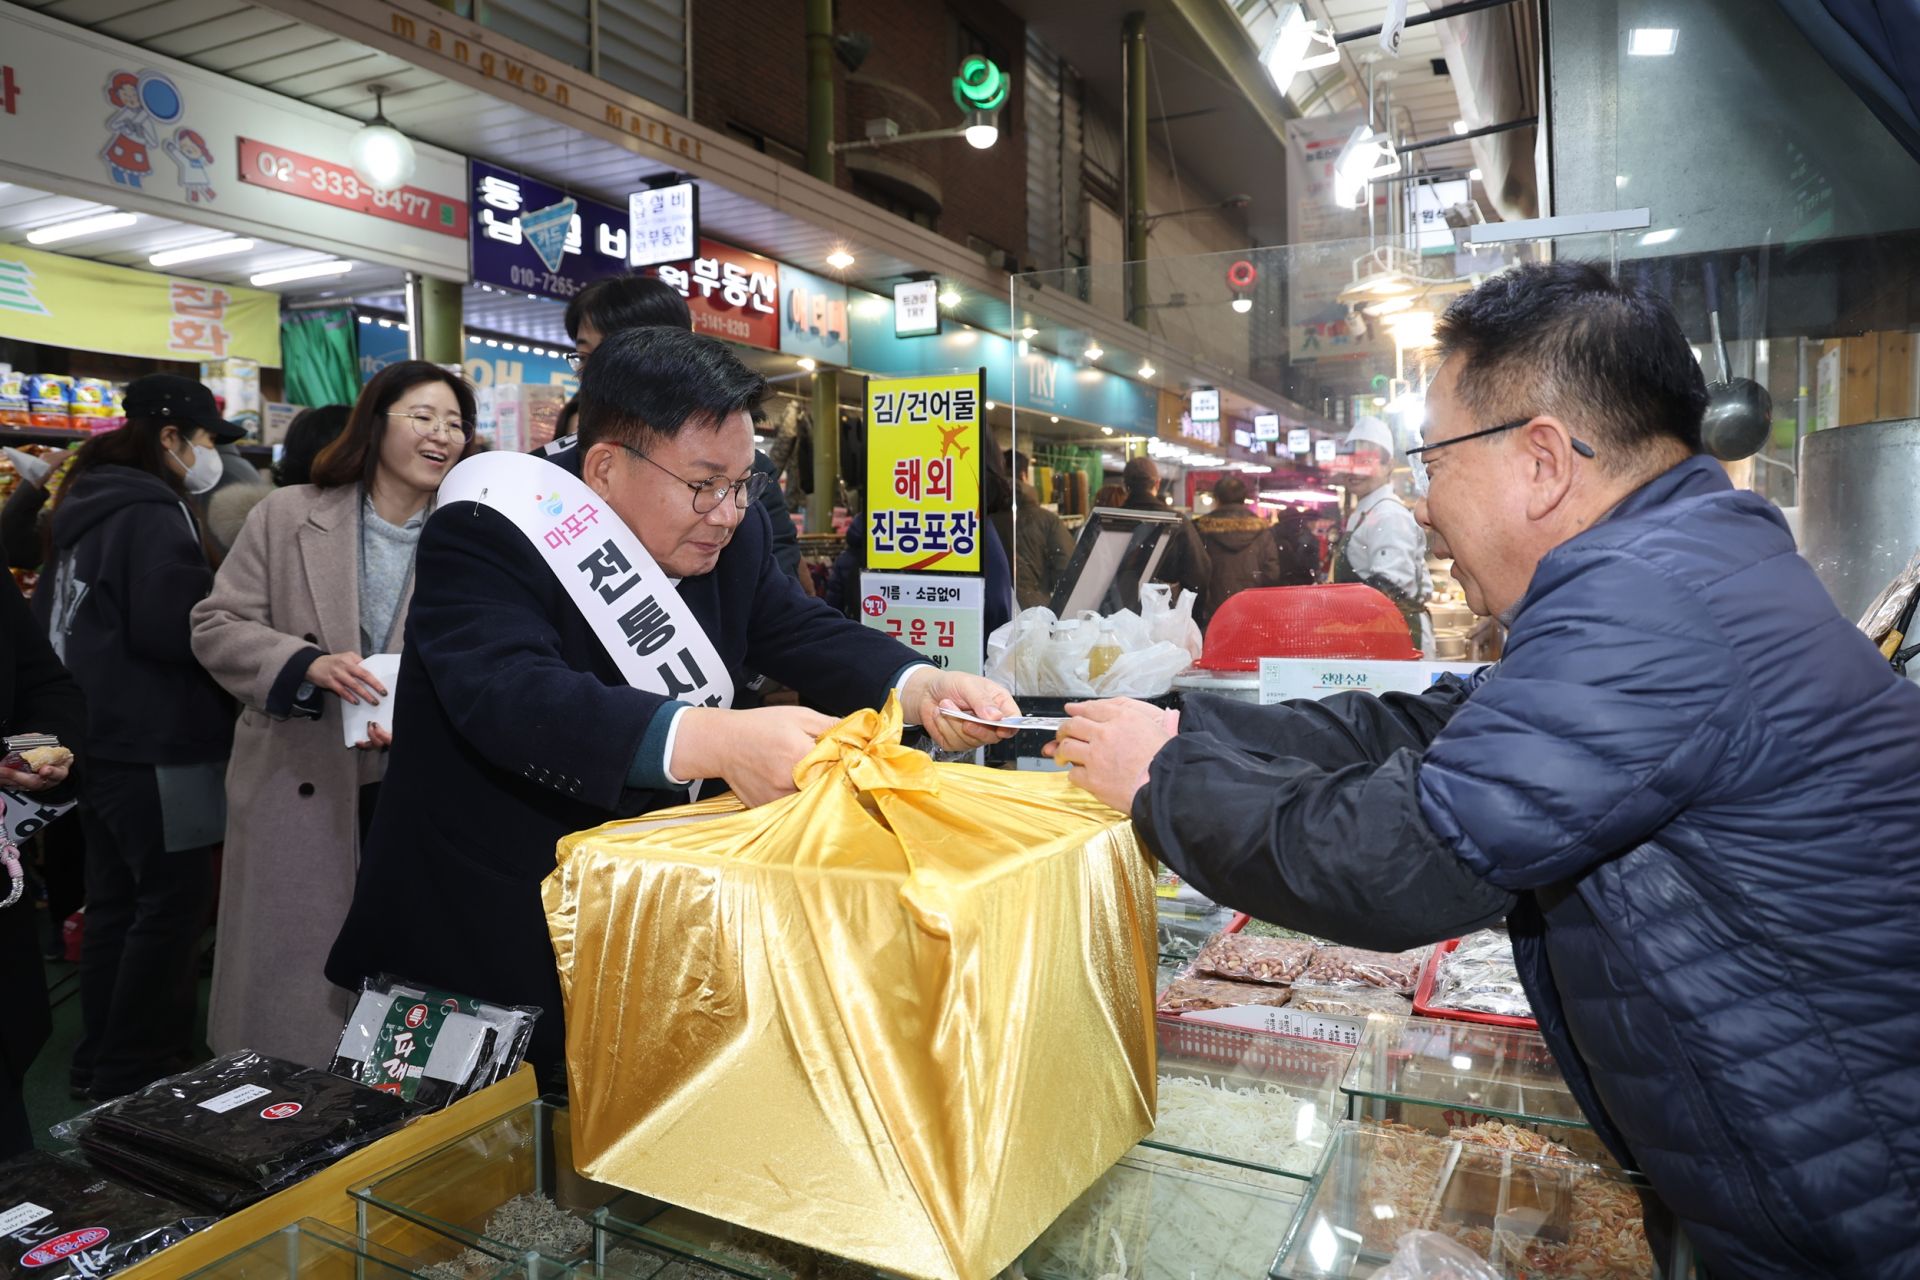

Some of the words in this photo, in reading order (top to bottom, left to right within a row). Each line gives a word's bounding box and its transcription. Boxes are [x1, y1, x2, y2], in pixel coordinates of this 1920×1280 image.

[391, 13, 571, 105] mangwon
[605, 104, 702, 160] market
[256, 151, 431, 219] 02-333-8477
[510, 264, 587, 298] 010-7265-
[171, 282, 230, 357] 잡화
[907, 307, 925, 318] TRY
[1028, 360, 1058, 401] TRY
[873, 390, 976, 424] 김/건어물
[894, 458, 952, 501] 해외
[543, 503, 599, 549] 마포구
[871, 510, 977, 555] 진공포장
[880, 585, 901, 600] 기름
[916, 586, 961, 602] 소금없이
[382, 1031, 416, 1081] 파래
